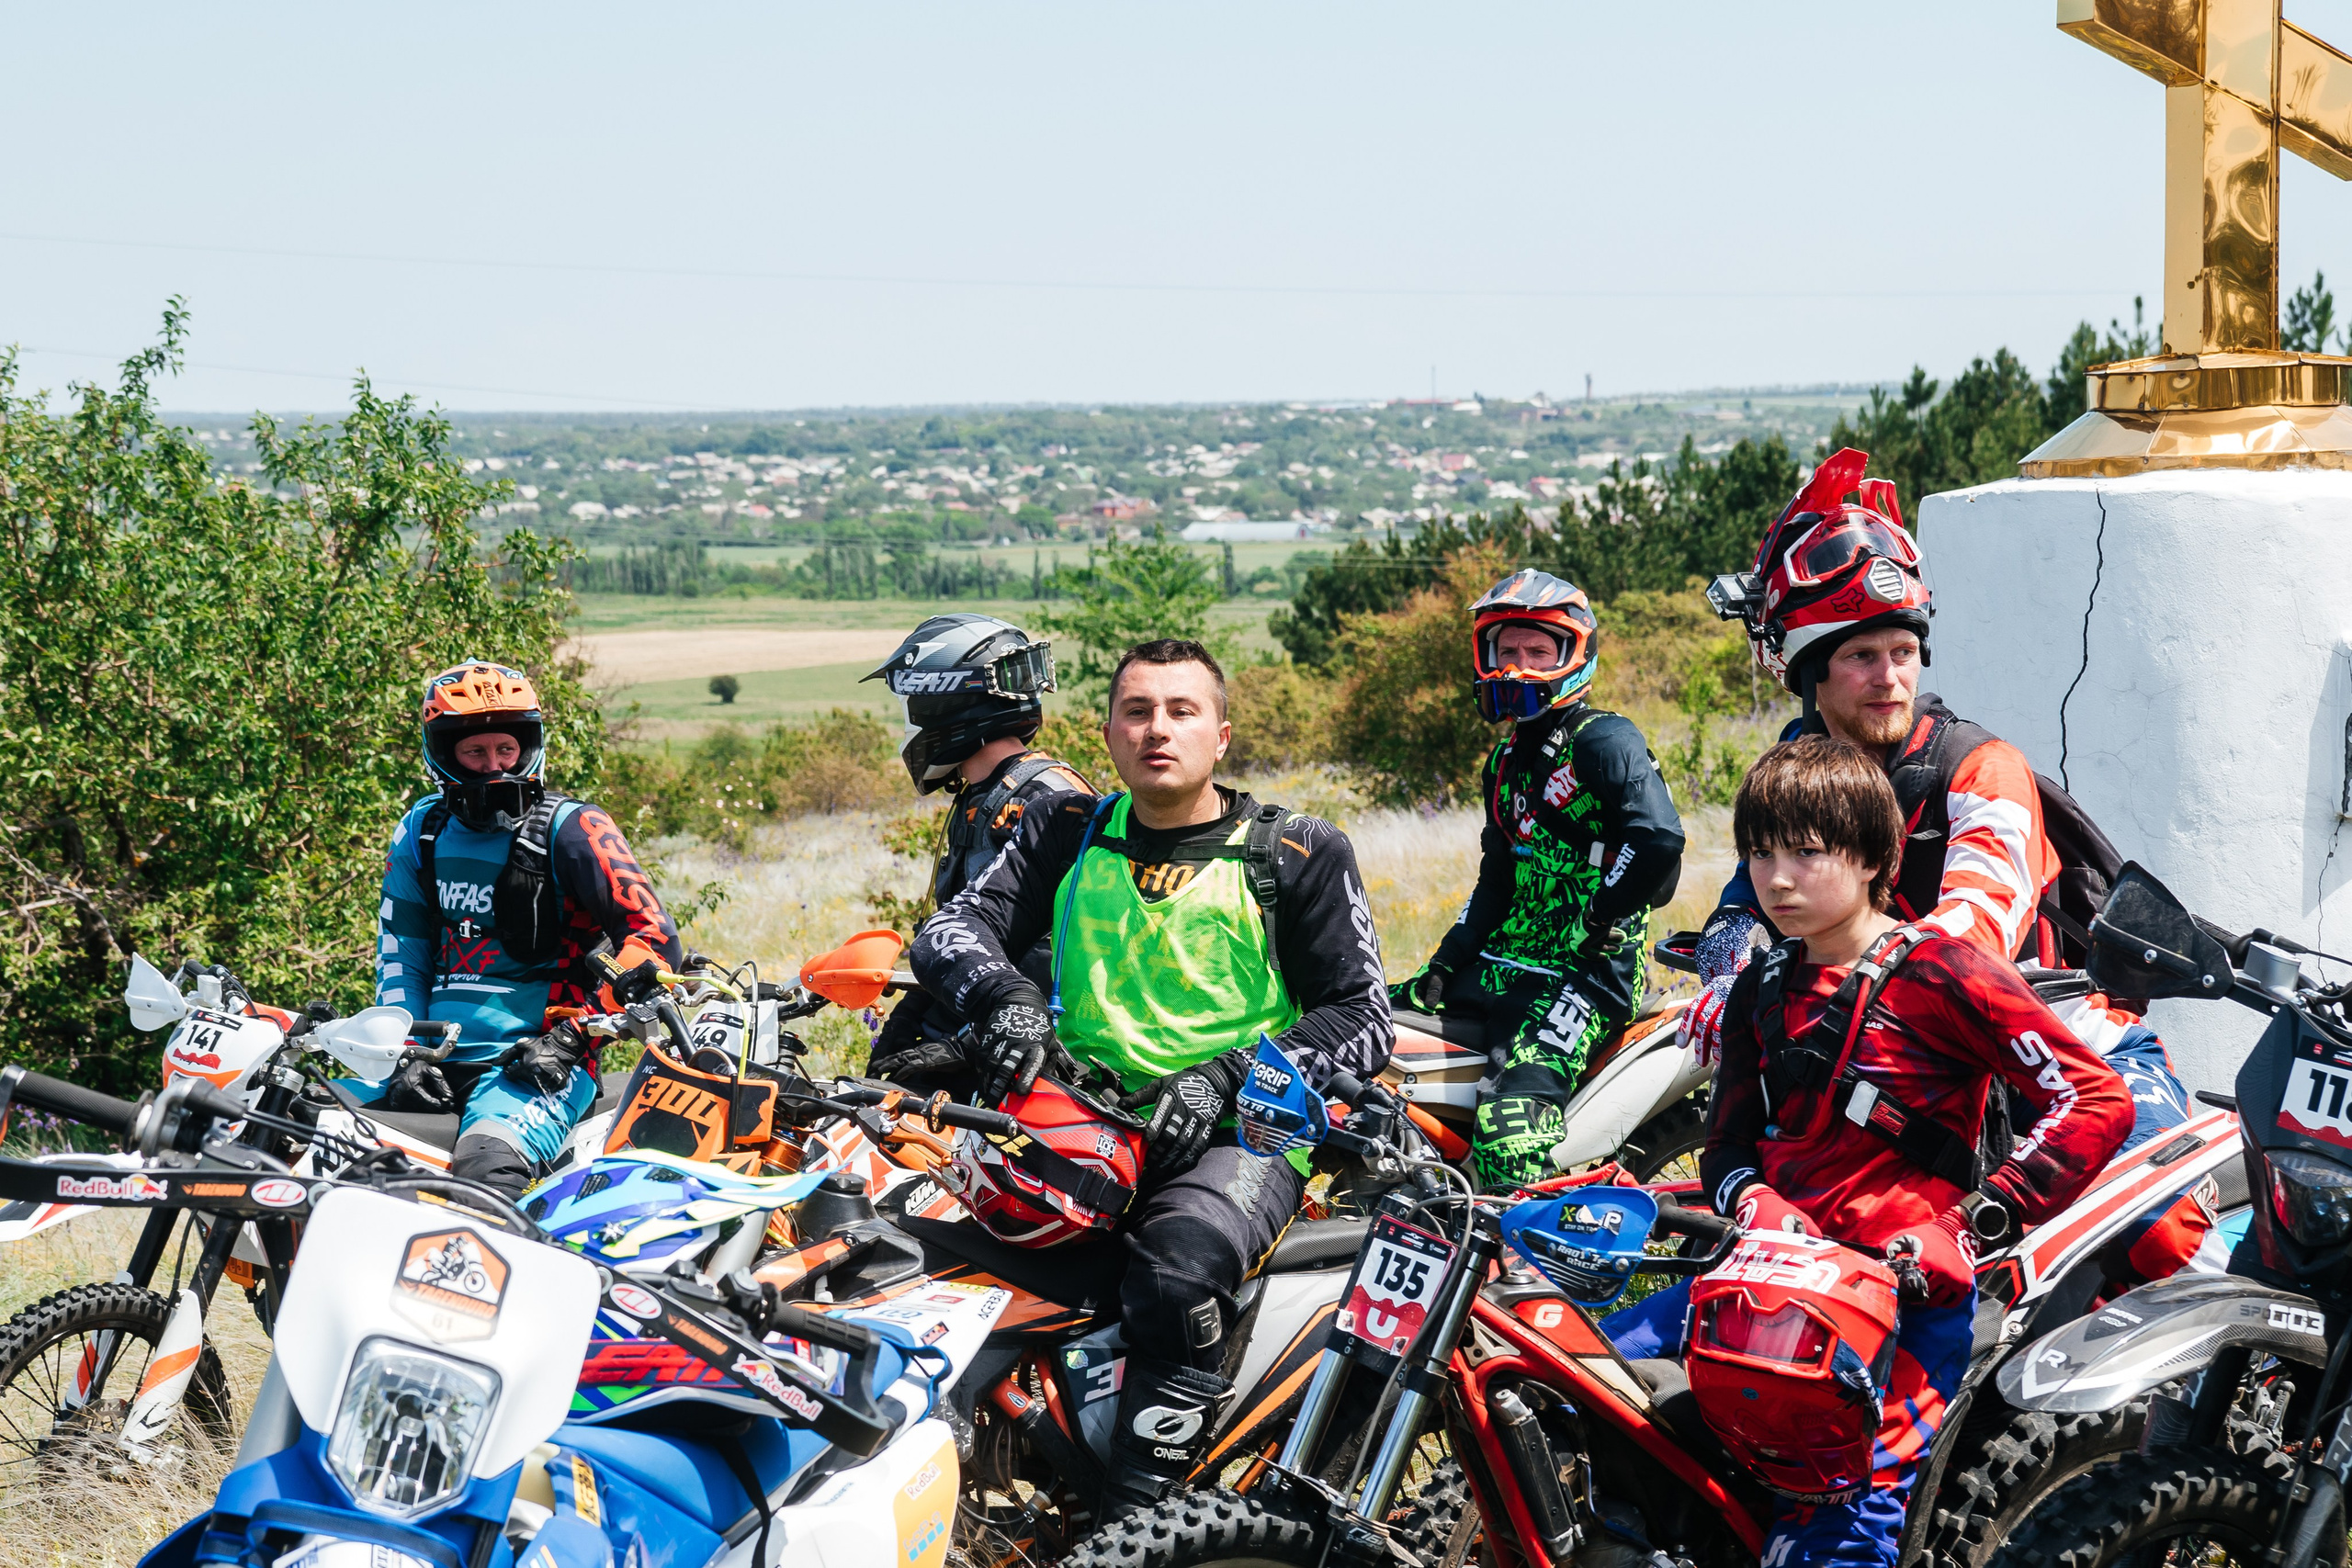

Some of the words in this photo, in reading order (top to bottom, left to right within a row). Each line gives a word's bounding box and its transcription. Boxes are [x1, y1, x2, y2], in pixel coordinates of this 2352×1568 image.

[187, 1023, 222, 1053] 141
[692, 1026, 729, 1048] 149
[642, 1076, 720, 1127] 300
[906, 1180, 936, 1213] KTM
[1374, 1247, 1431, 1301] 135
[1566, 1257, 1600, 1271] RACE
[977, 1288, 1007, 1321] ACERBIS
[1533, 1303, 1565, 1328] G
